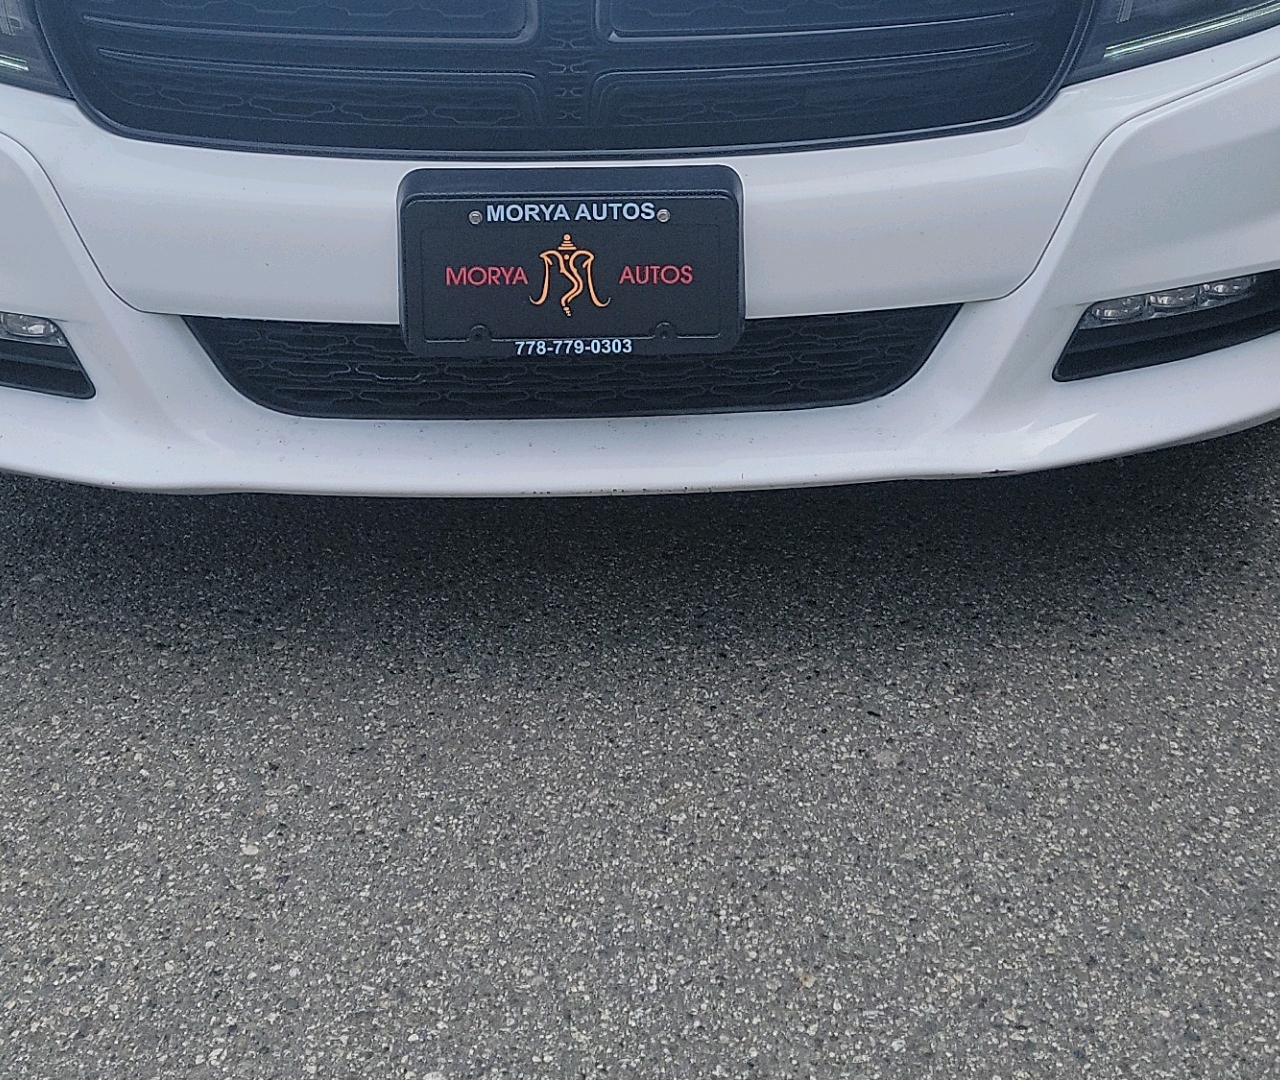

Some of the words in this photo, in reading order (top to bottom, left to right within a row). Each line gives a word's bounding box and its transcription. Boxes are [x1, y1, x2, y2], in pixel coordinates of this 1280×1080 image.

[486, 204, 570, 222] MORYA
[574, 202, 656, 221] AUTOS
[445, 266, 529, 286] MORYA
[618, 265, 693, 285] AUTOS
[515, 338, 633, 356] 778-779-0303
